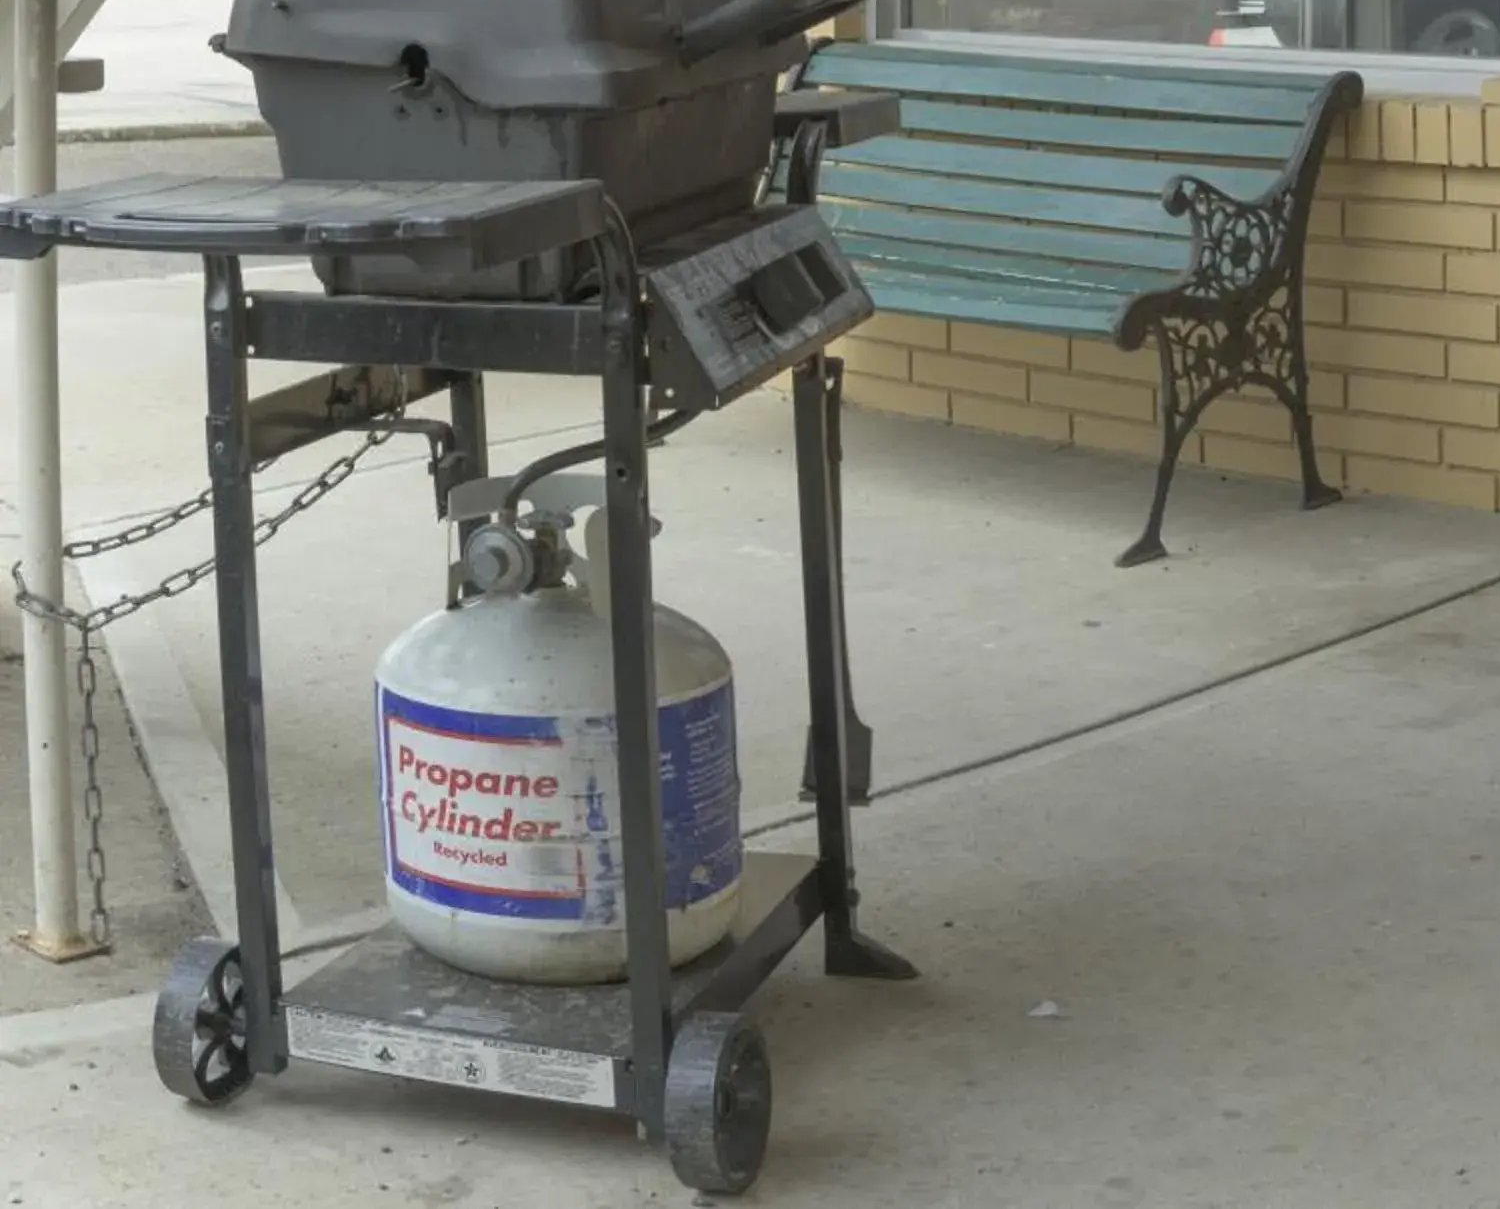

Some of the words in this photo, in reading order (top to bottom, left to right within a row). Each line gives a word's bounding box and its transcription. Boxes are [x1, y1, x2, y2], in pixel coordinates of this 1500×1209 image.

[399, 744, 559, 798] Propane
[401, 790, 561, 841] Cylinder
[433, 841, 508, 867] Recycled
